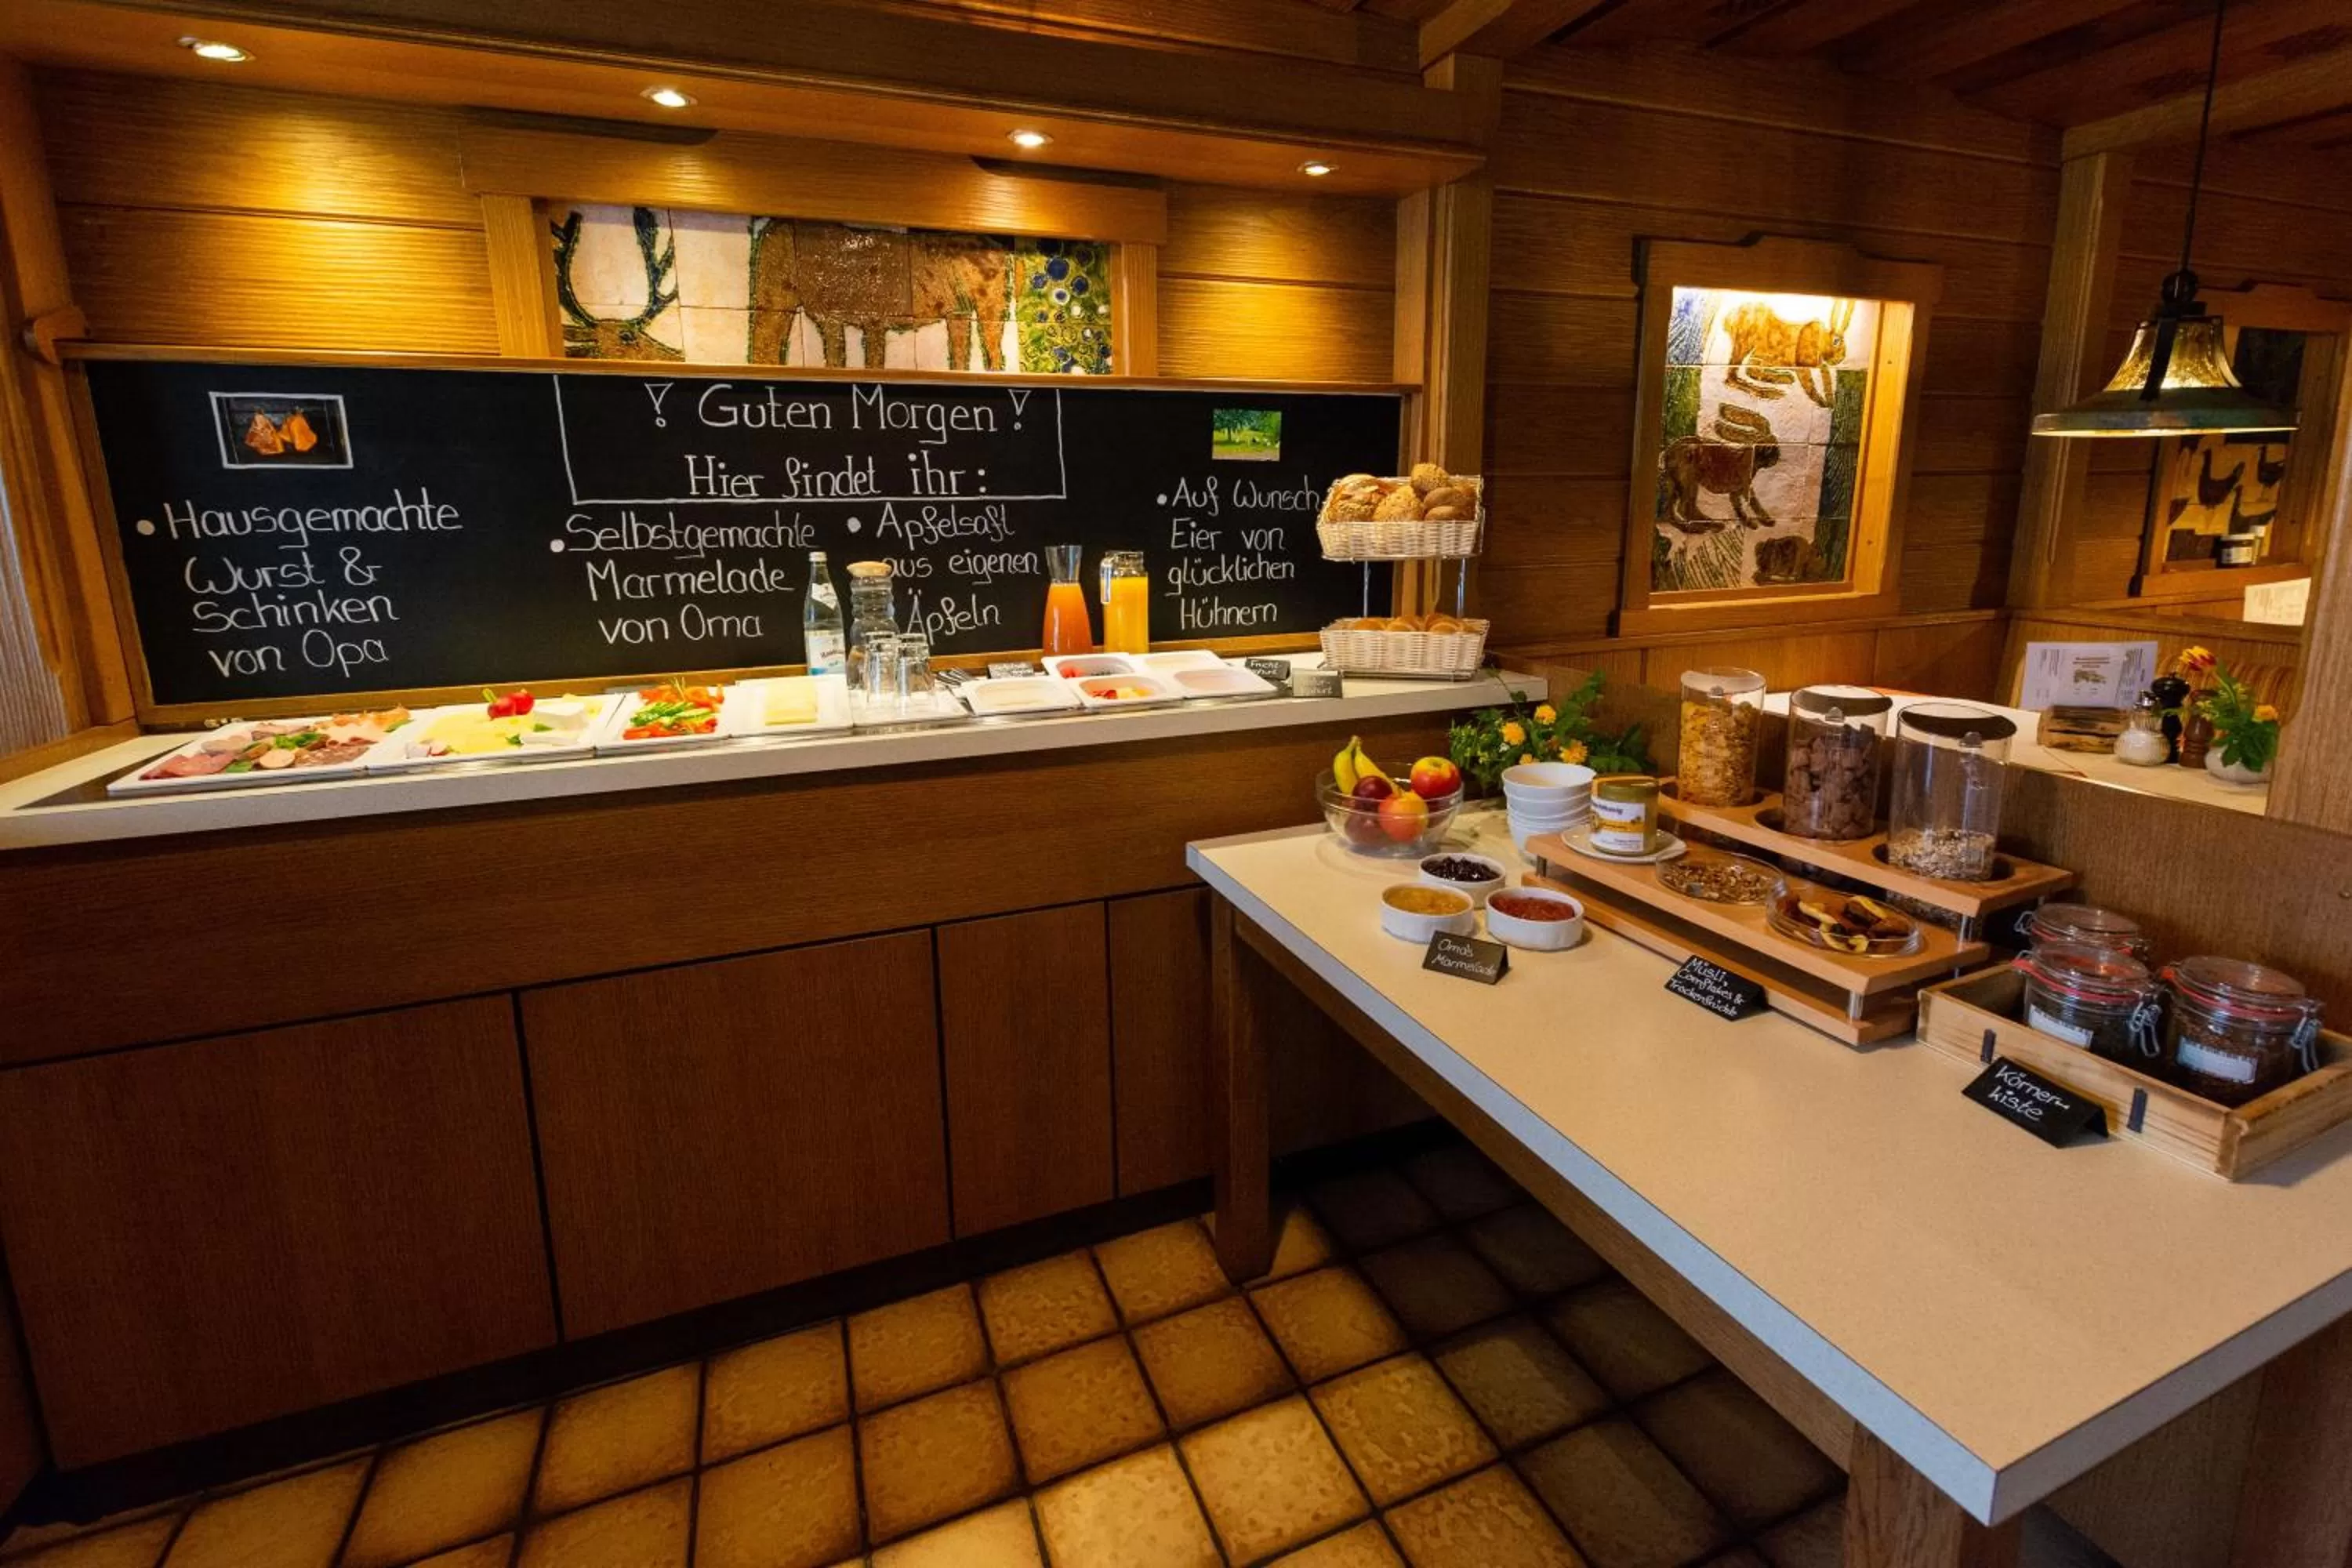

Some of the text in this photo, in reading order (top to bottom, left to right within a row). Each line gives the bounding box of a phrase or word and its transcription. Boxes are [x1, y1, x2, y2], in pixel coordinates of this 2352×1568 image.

[699, 383, 833, 430] Guten
[851, 383, 999, 445] Morgen
[684, 454, 765, 497] Hier
[782, 454, 882, 499] findet
[1171, 474, 1321, 517] Auf Wunsch
[163, 486, 464, 550] Hausgemachte
[565, 510, 823, 561] Selbstgemachte
[876, 501, 1016, 551] Apfelsaft
[1171, 516, 1287, 552] Eier von
[183, 546, 383, 595] Wurst &
[586, 557, 797, 603] Marmelade
[948, 548, 1042, 585] eigenen
[1163, 552, 1296, 597] glücklichen
[191, 588, 401, 633] Schinken
[599, 603, 765, 646] von Oma
[906, 586, 1002, 647] Äpfeln
[1180, 595, 1279, 631] Hühnern
[207, 628, 391, 679] von Opa
[1733, 993, 1746, 1005] &
[1987, 1085, 2044, 1122] kiste
